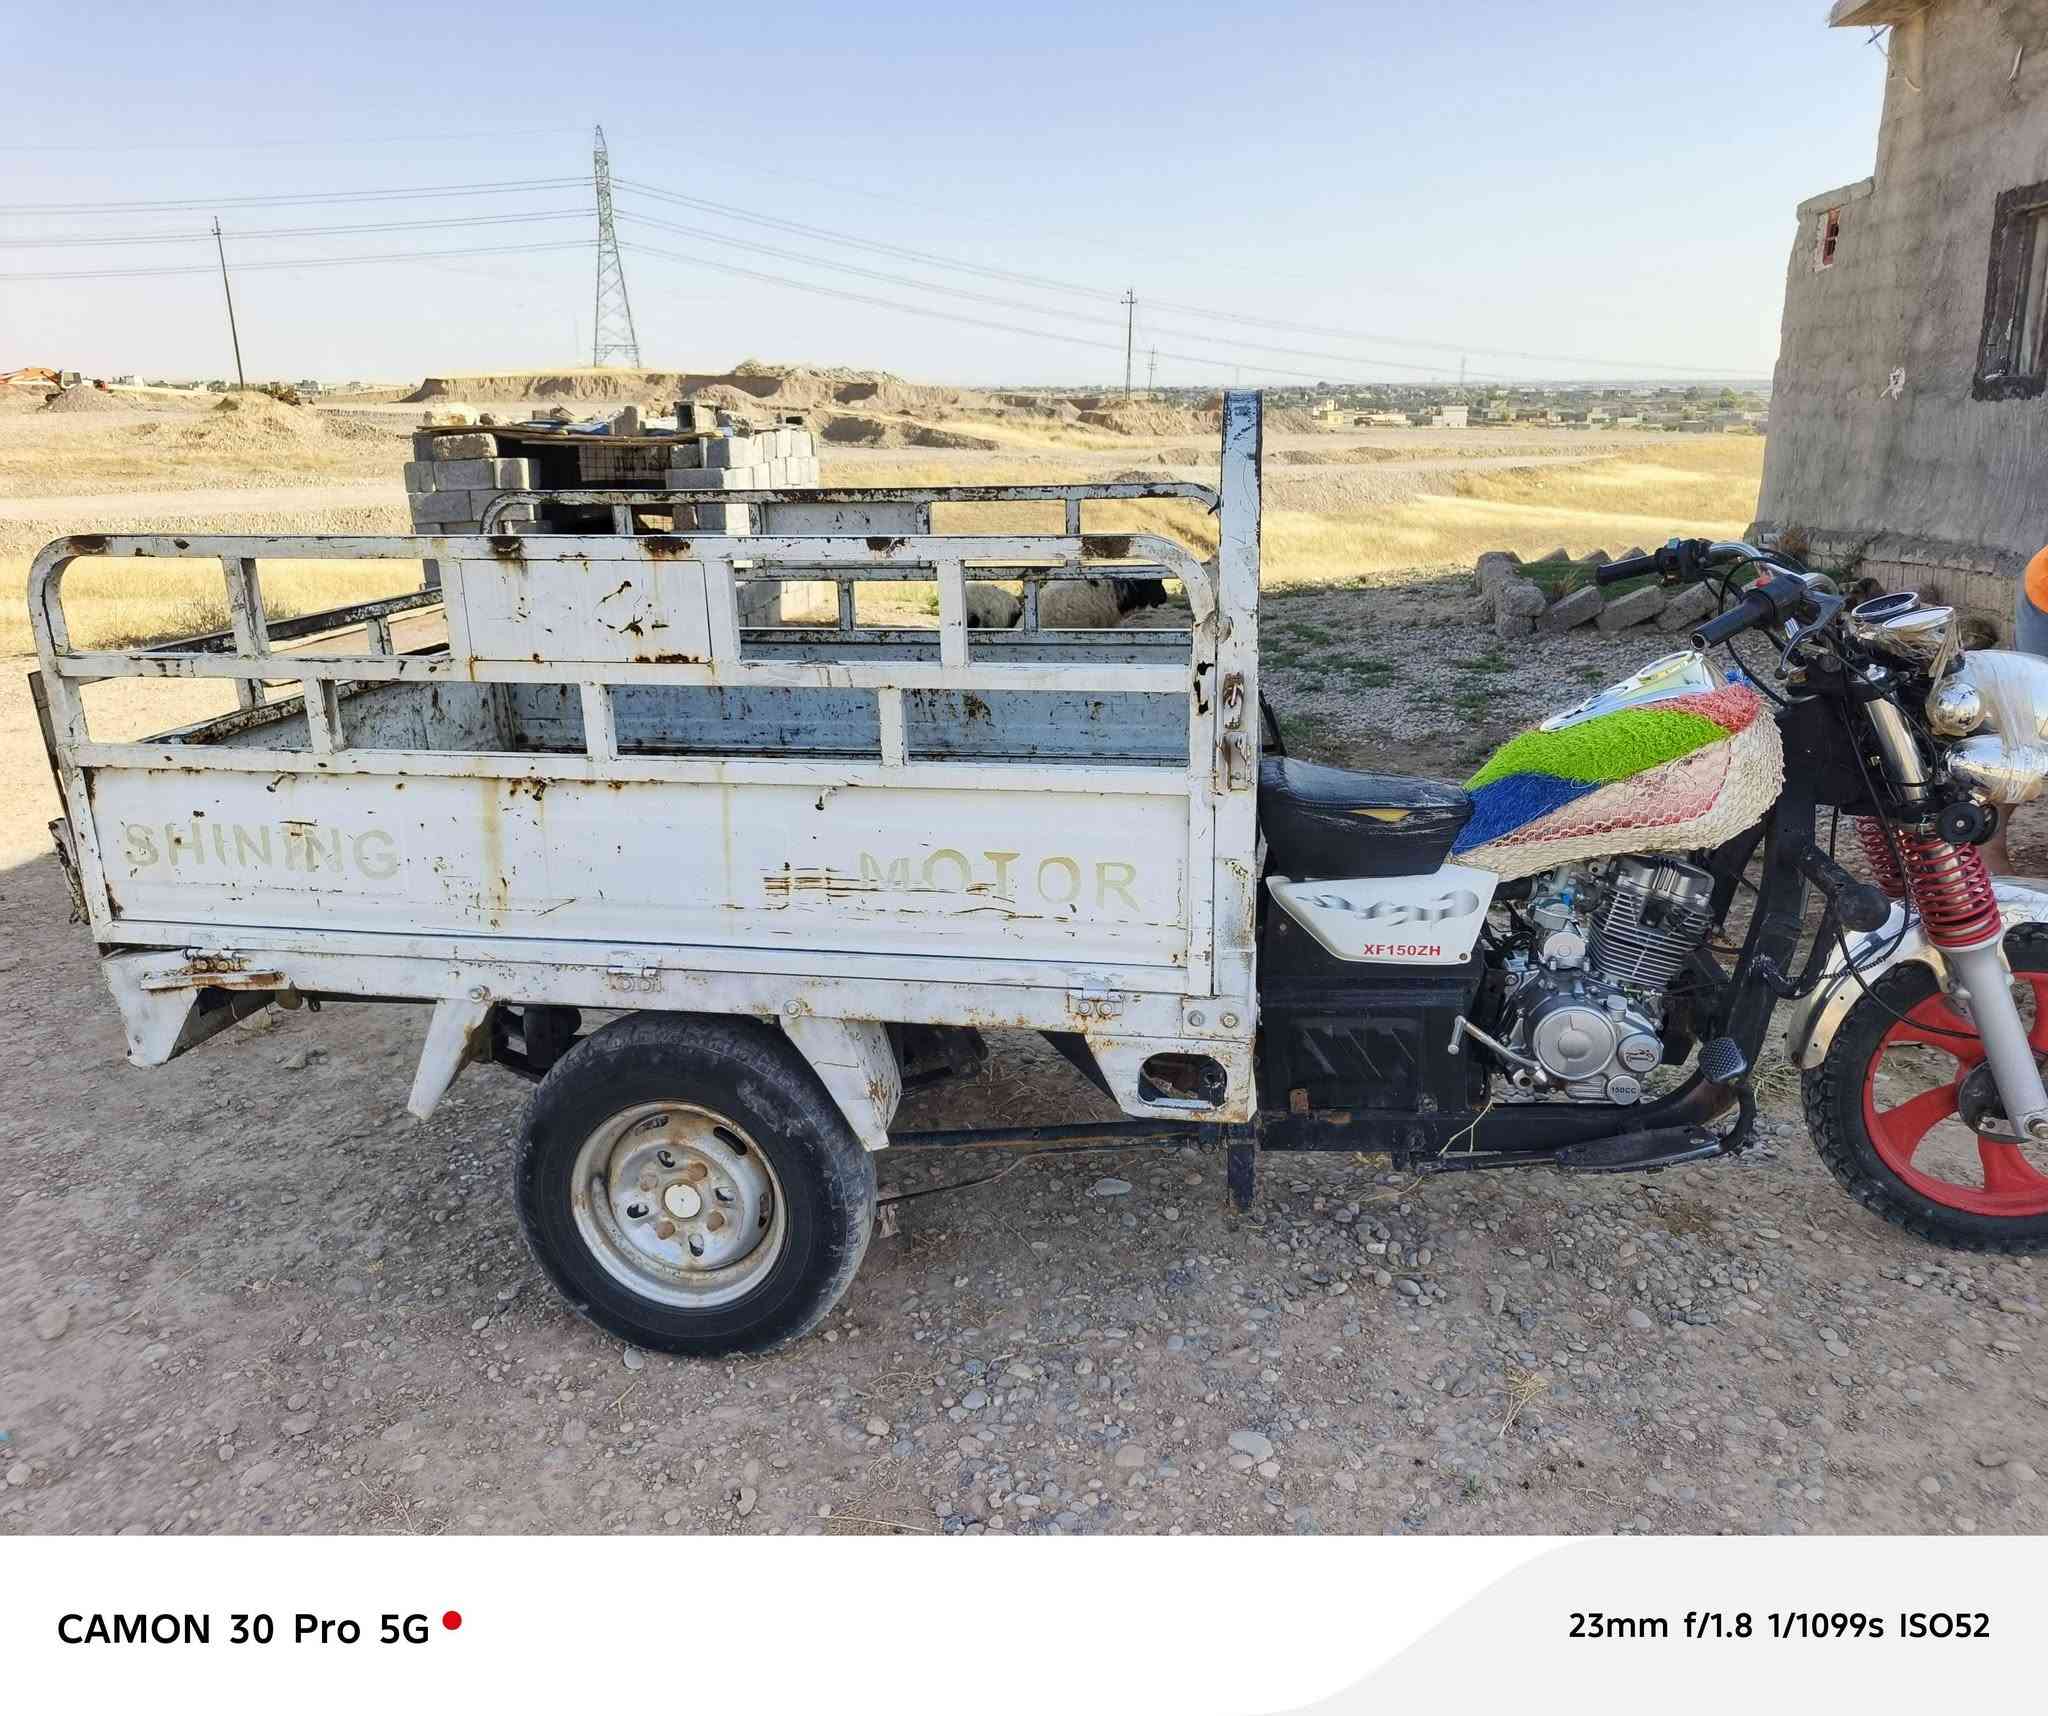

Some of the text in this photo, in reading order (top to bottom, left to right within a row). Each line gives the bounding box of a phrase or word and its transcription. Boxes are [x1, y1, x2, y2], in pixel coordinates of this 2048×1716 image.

[126, 823, 1141, 912] SHINING MOTOR
[1363, 943, 1441, 956] XF150ZH
